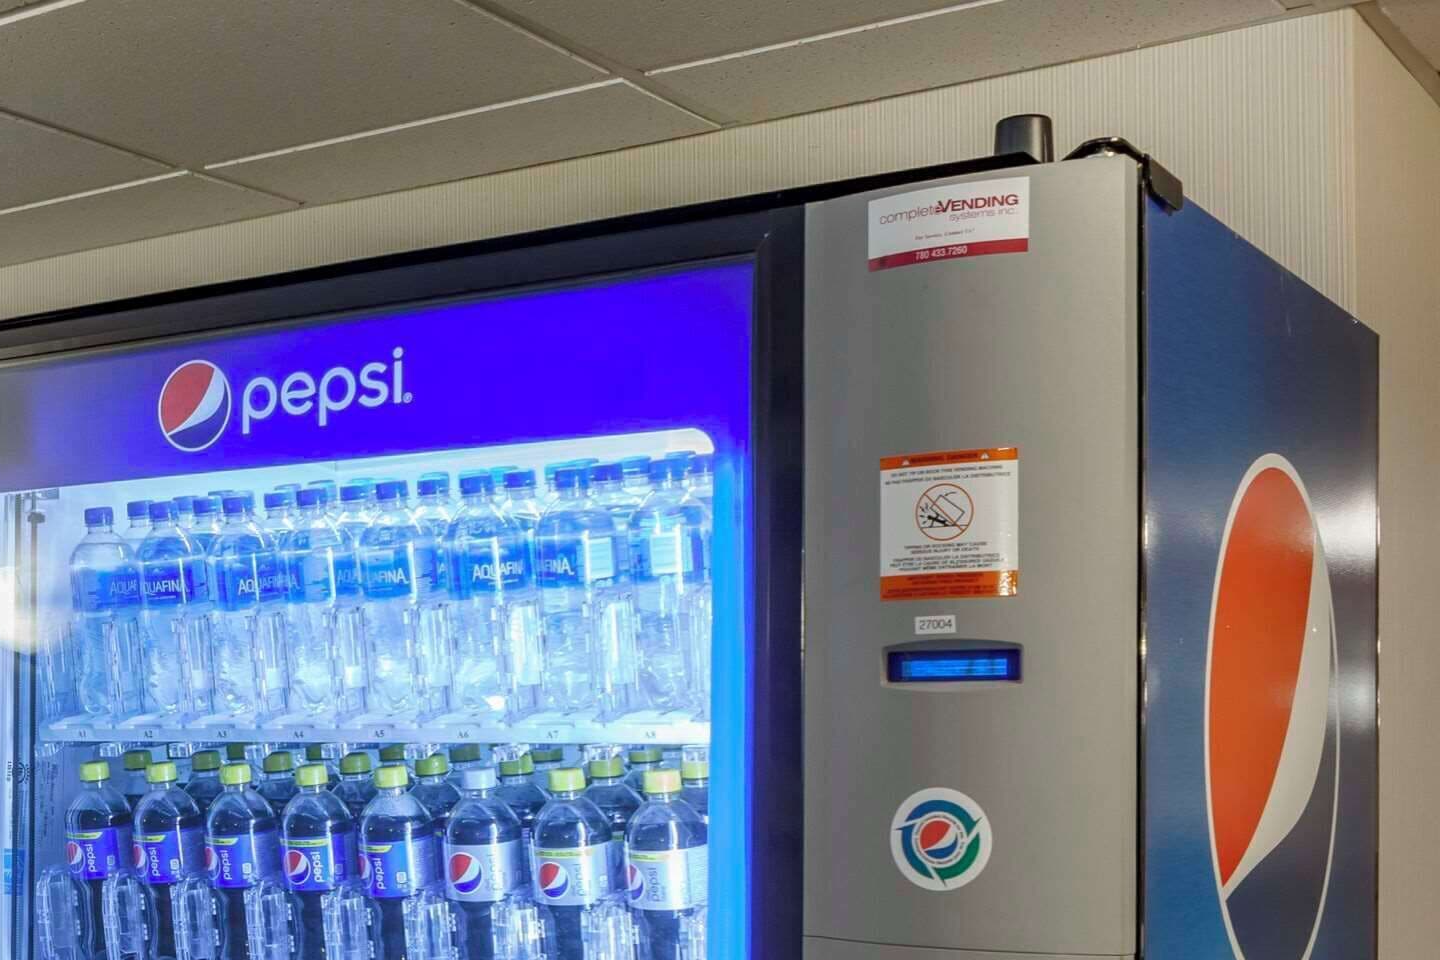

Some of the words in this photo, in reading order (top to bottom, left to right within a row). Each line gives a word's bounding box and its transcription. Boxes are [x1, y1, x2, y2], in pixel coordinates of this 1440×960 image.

[949, 207, 995, 222] systems
[241, 348, 406, 431] pepsi
[918, 619, 953, 630] 27004
[88, 843, 97, 873] pepsi
[150, 847, 160, 877] pepsi
[224, 850, 233, 880] pepsi
[313, 851, 325, 883] pepsi
[376, 858, 386, 890] pepsi
[648, 867, 660, 902] pepsi
